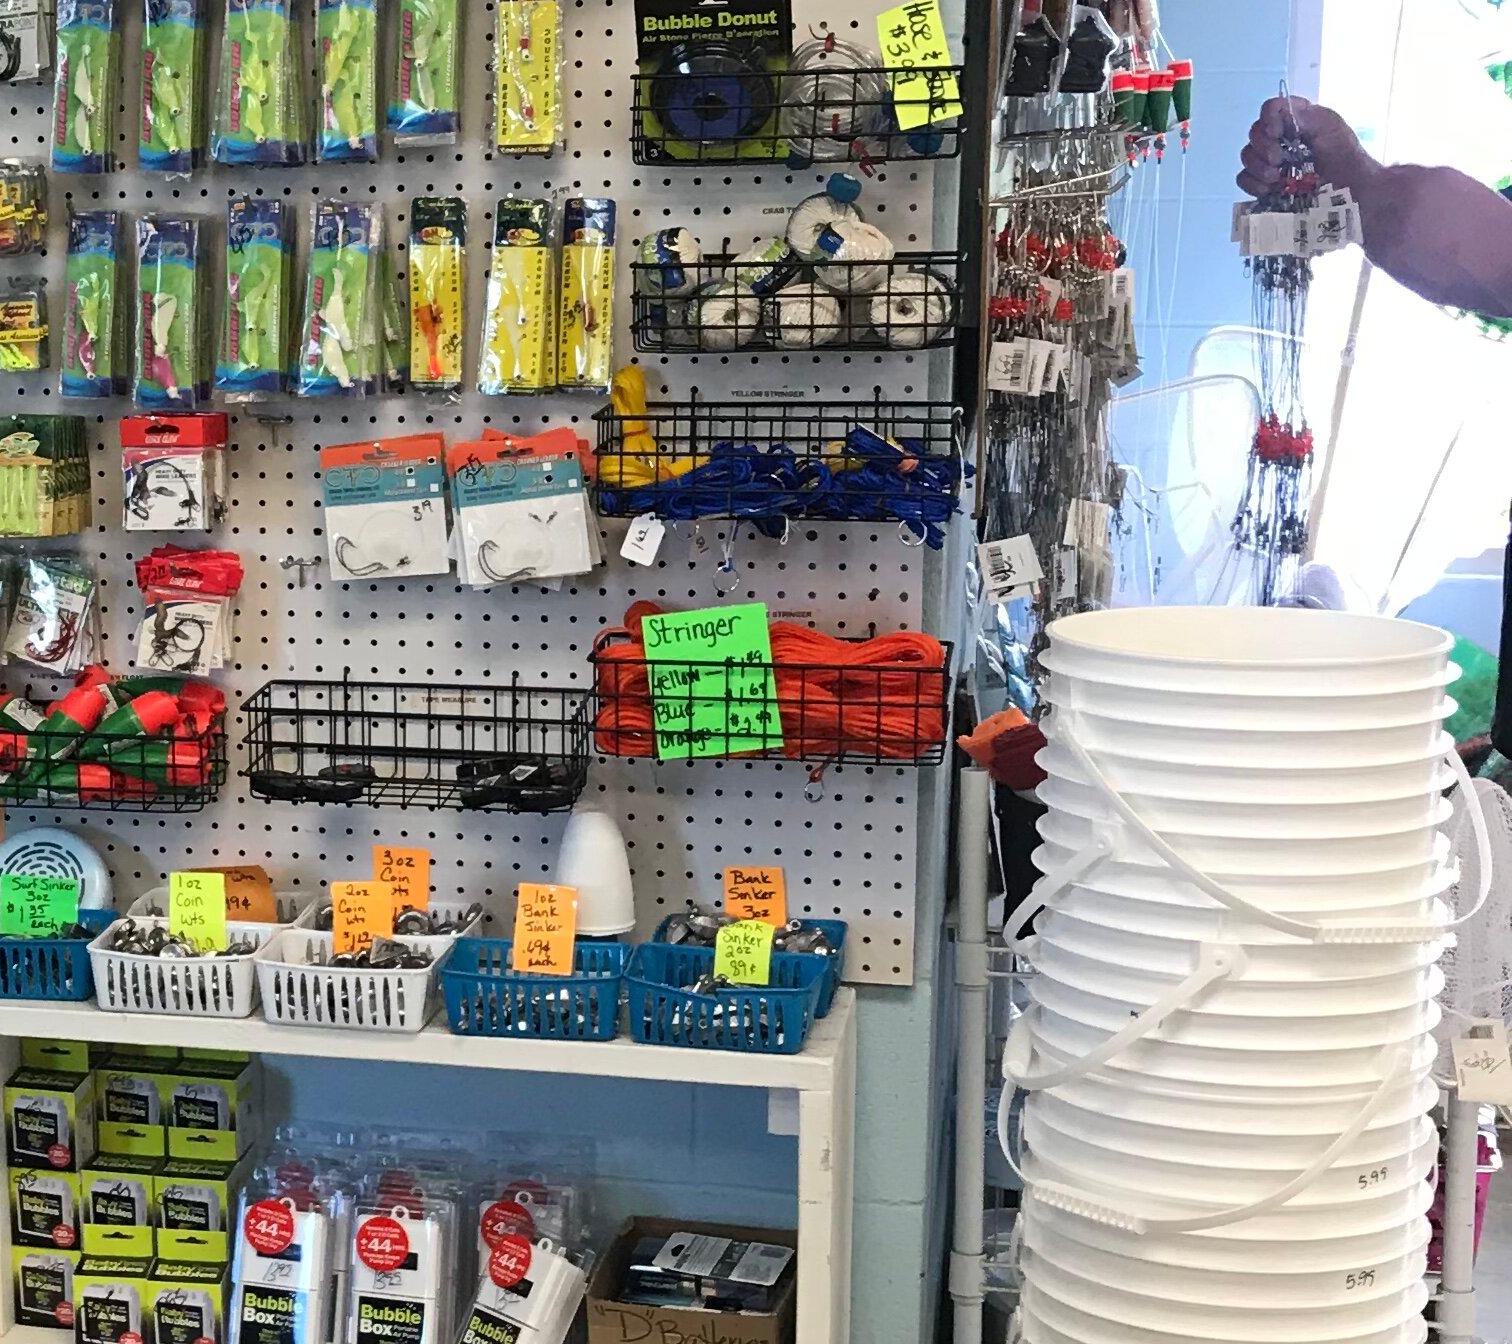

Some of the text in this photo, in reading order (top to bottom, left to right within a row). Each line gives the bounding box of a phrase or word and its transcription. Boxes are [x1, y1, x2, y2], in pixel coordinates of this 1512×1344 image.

[643, 9, 778, 31] Bubble Donut
[642, 33, 688, 43] Air Stone
[647, 613, 743, 649] Stringer
[11, 877, 76, 892] Surf Sinker
[380, 867, 410, 885] Coin
[731, 870, 773, 885] Bank
[176, 892, 204, 908] Coin
[338, 900, 368, 914] Coin
[522, 904, 560, 919] Bank
[31, 920, 60, 931] each
[722, 929, 766, 947] Sinker
[244, 1293, 304, 1314] Bubble
[243, 1308, 276, 1326] Box
[359, 1304, 424, 1325] Bubble
[359, 1319, 393, 1336] Box
